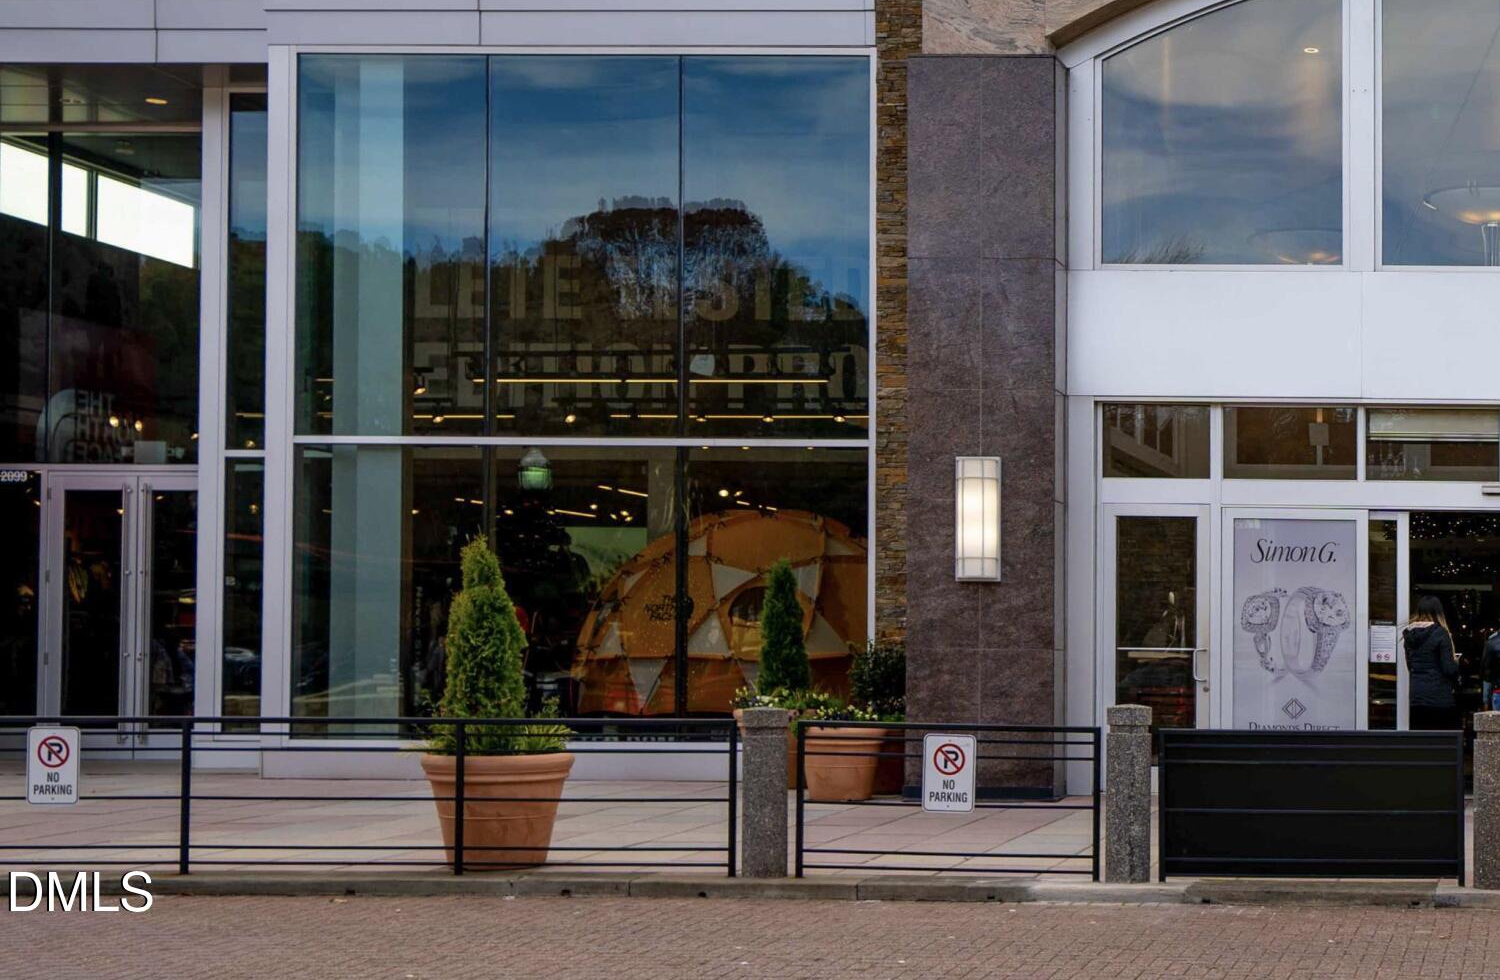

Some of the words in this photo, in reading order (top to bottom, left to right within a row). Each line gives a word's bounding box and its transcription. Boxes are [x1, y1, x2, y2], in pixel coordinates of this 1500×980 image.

[1, 471, 28, 482] 2099
[47, 771, 60, 783] NO
[33, 784, 73, 796] PARKING
[942, 779, 956, 790] NO
[929, 791, 968, 803] PARKING
